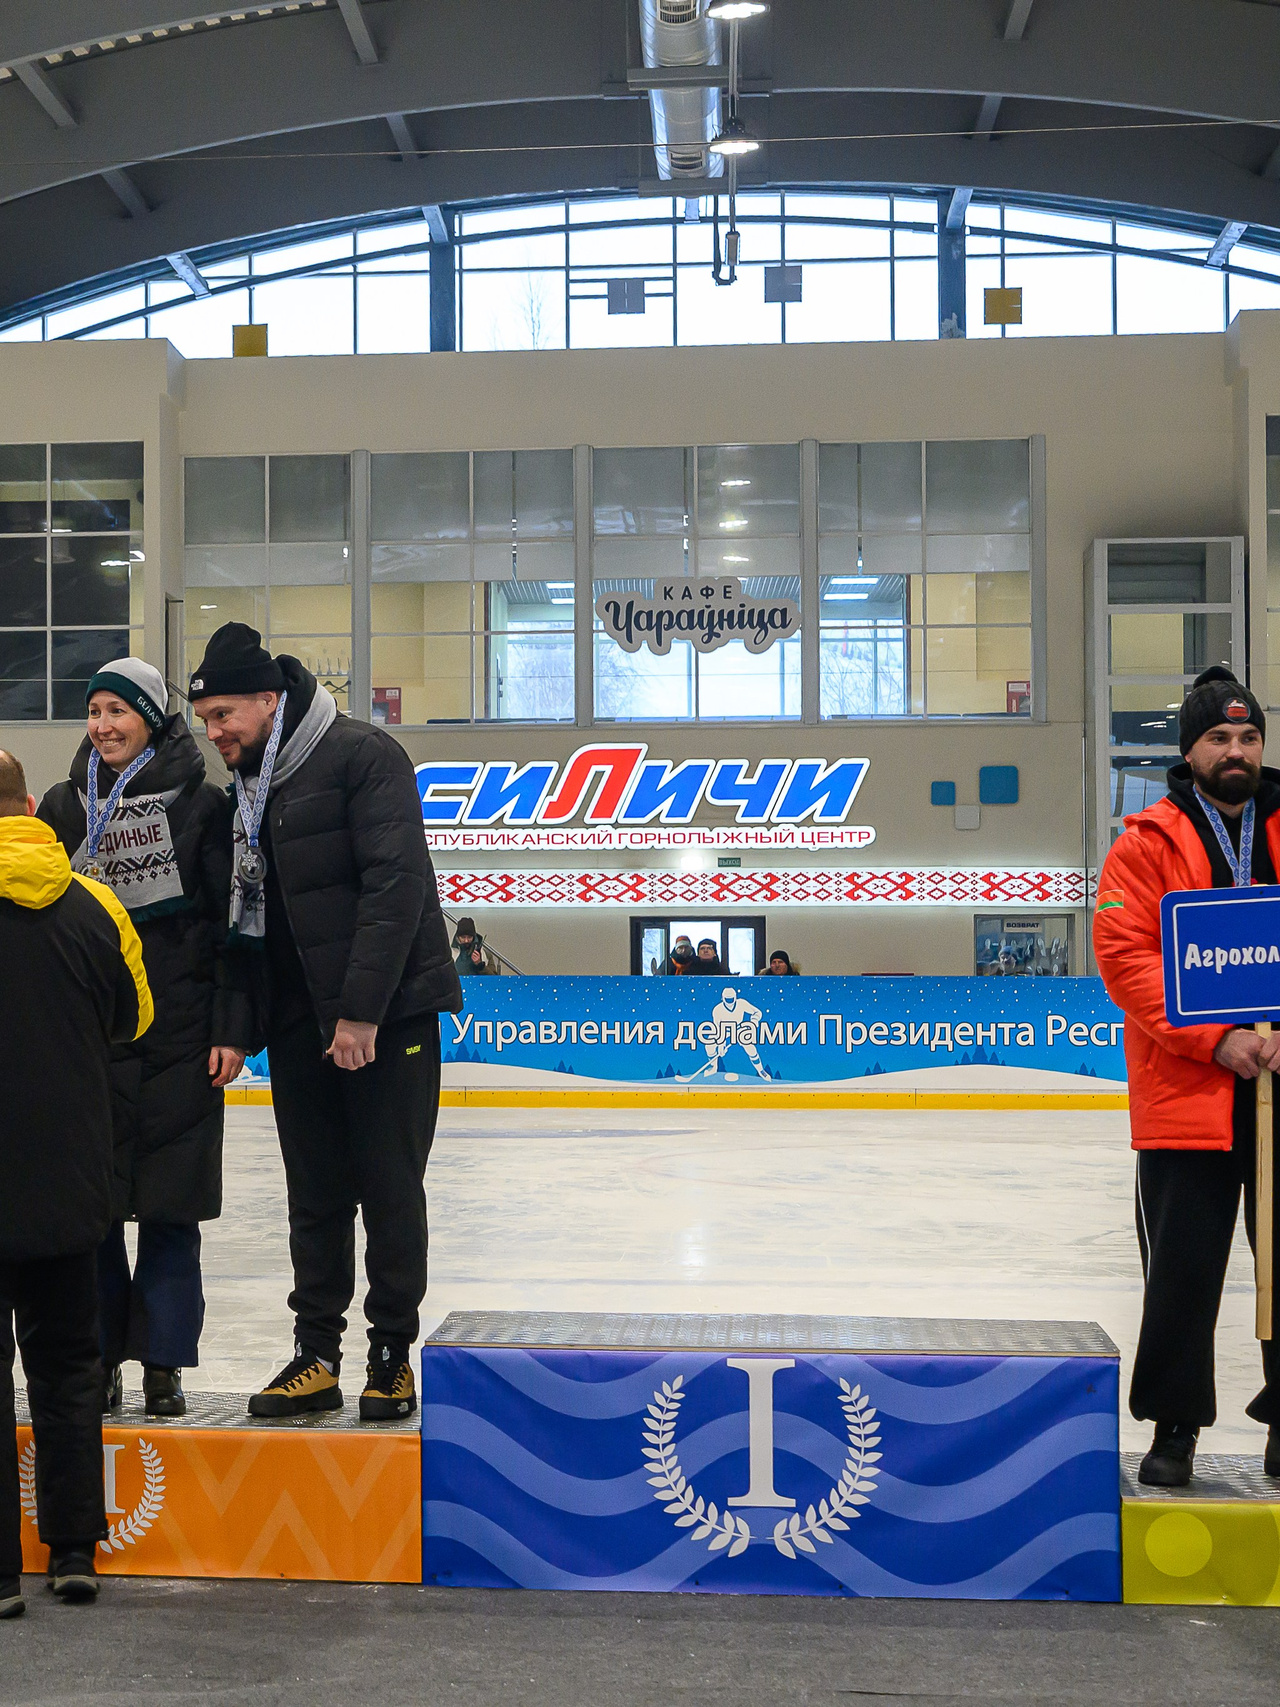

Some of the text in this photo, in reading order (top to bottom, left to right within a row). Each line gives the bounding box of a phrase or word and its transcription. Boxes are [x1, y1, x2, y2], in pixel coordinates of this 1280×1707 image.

[663, 585, 732, 600] КАФЕ
[604, 600, 793, 647] Чараўніца
[618, 829, 794, 845] ГОРНОЛЫЖНЫЙ
[801, 831, 871, 846] ЦЕНТР
[1184, 943, 1280, 974] Агрохол
[450, 1013, 664, 1052] Управления
[673, 1021, 807, 1050] делами
[819, 1014, 1035, 1053] Президента
